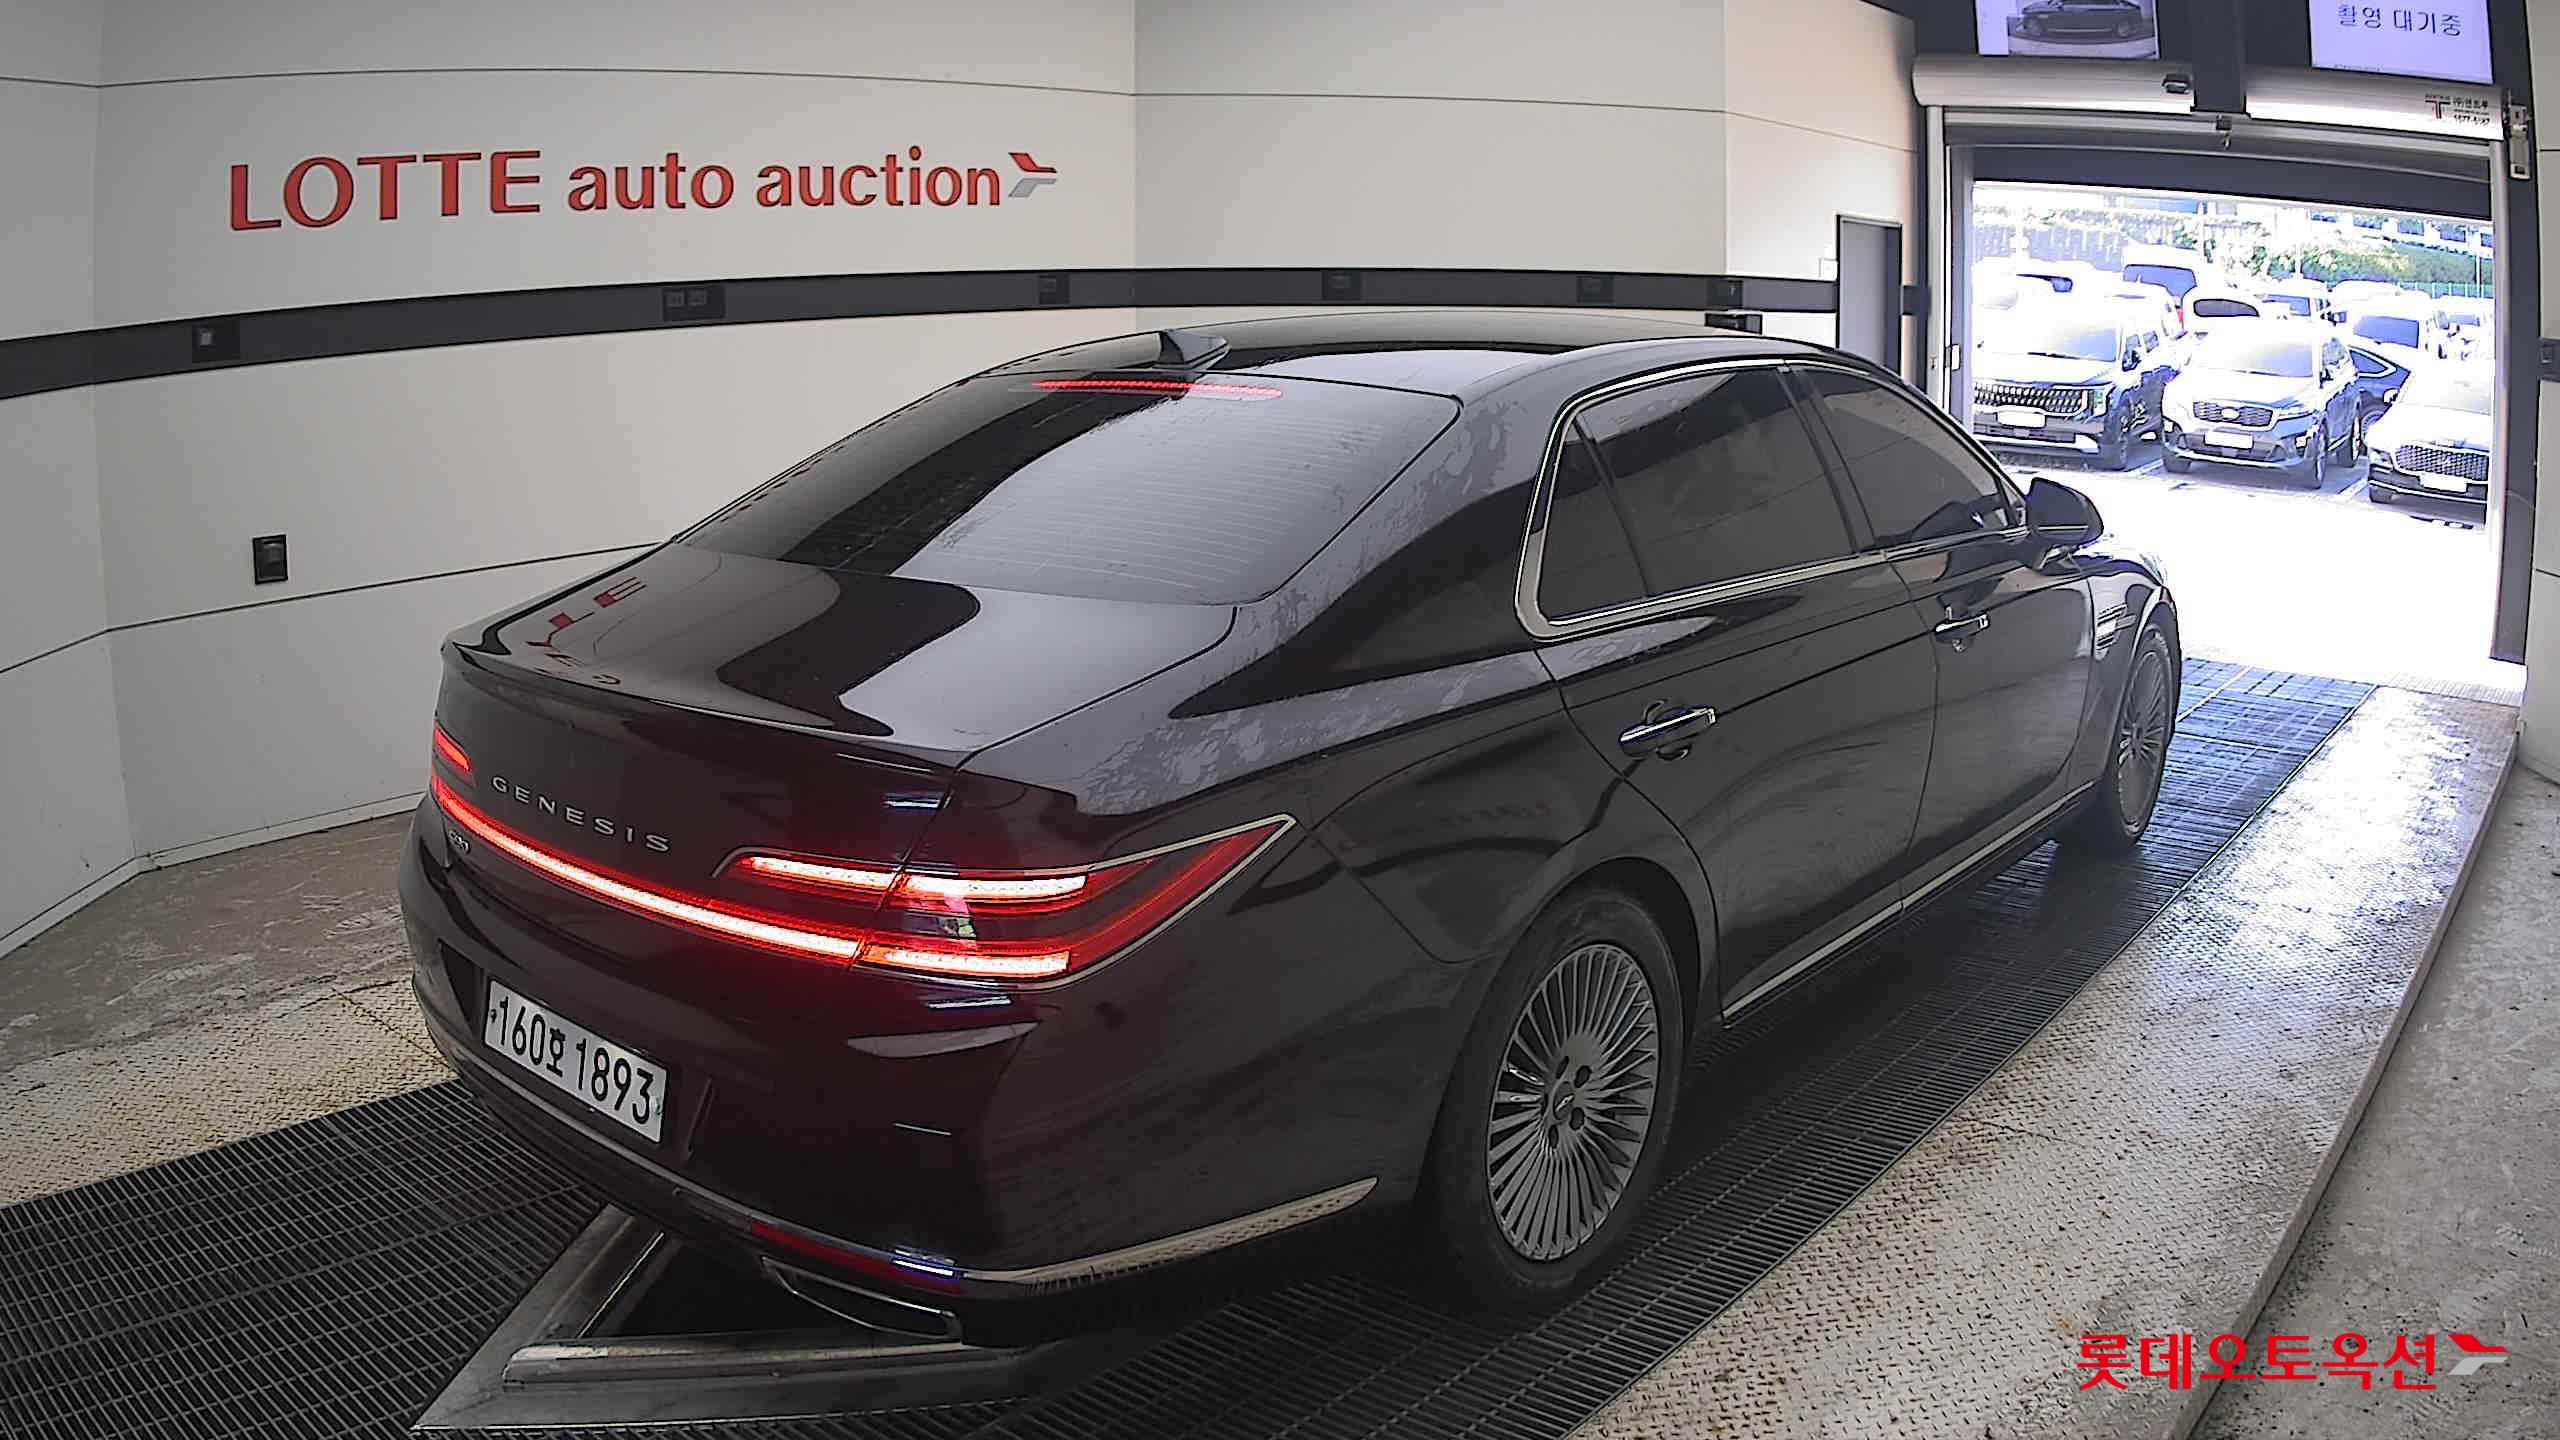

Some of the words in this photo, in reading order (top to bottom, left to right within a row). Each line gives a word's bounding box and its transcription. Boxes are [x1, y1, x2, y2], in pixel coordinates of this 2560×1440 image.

[2337, 4, 2383, 30] 촬영
[2393, 9, 2462, 37] 대기중
[230, 150, 541, 231] LOTTE
[568, 152, 735, 209] auto
[756, 146, 1001, 206] auction
[492, 776, 671, 852] GENESIS
